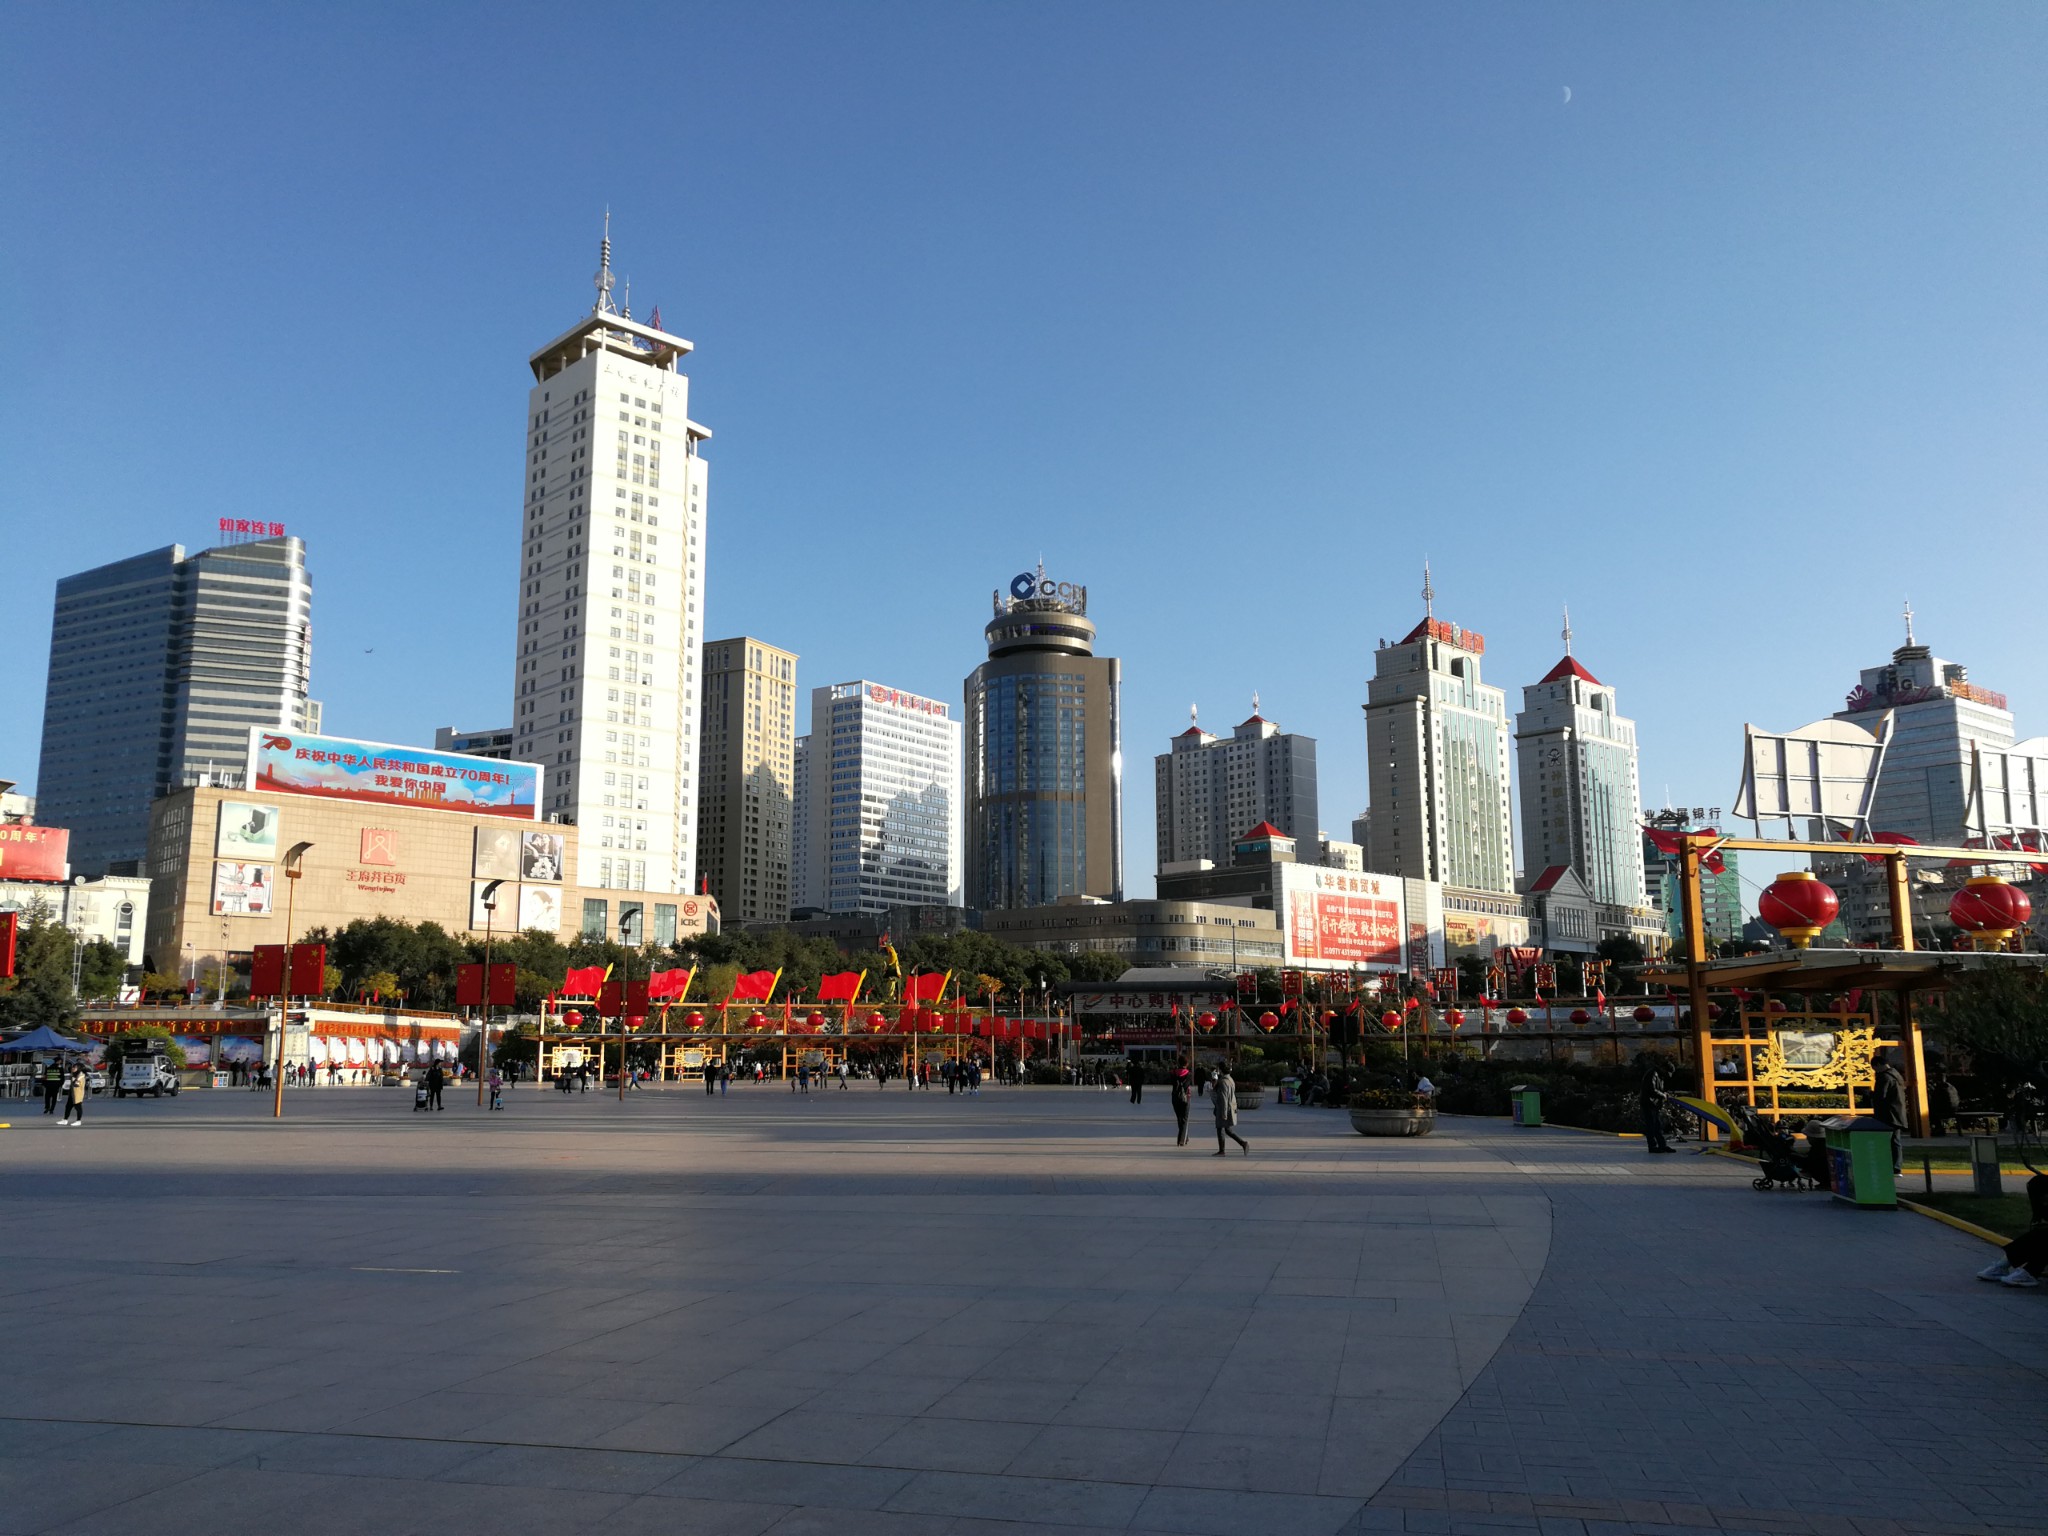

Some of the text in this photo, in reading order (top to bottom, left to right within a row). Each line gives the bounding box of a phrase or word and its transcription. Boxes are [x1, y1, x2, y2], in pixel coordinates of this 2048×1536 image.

[219, 517, 285, 537] 如家连锁
[374, 774, 446, 793] 我爱你中国
[346, 869, 406, 885] 王府井百货
[1324, 873, 1380, 896] 华德商贸城
[680, 918, 700, 927] ICBC
[1110, 992, 1226, 1009] 中心购物广场
